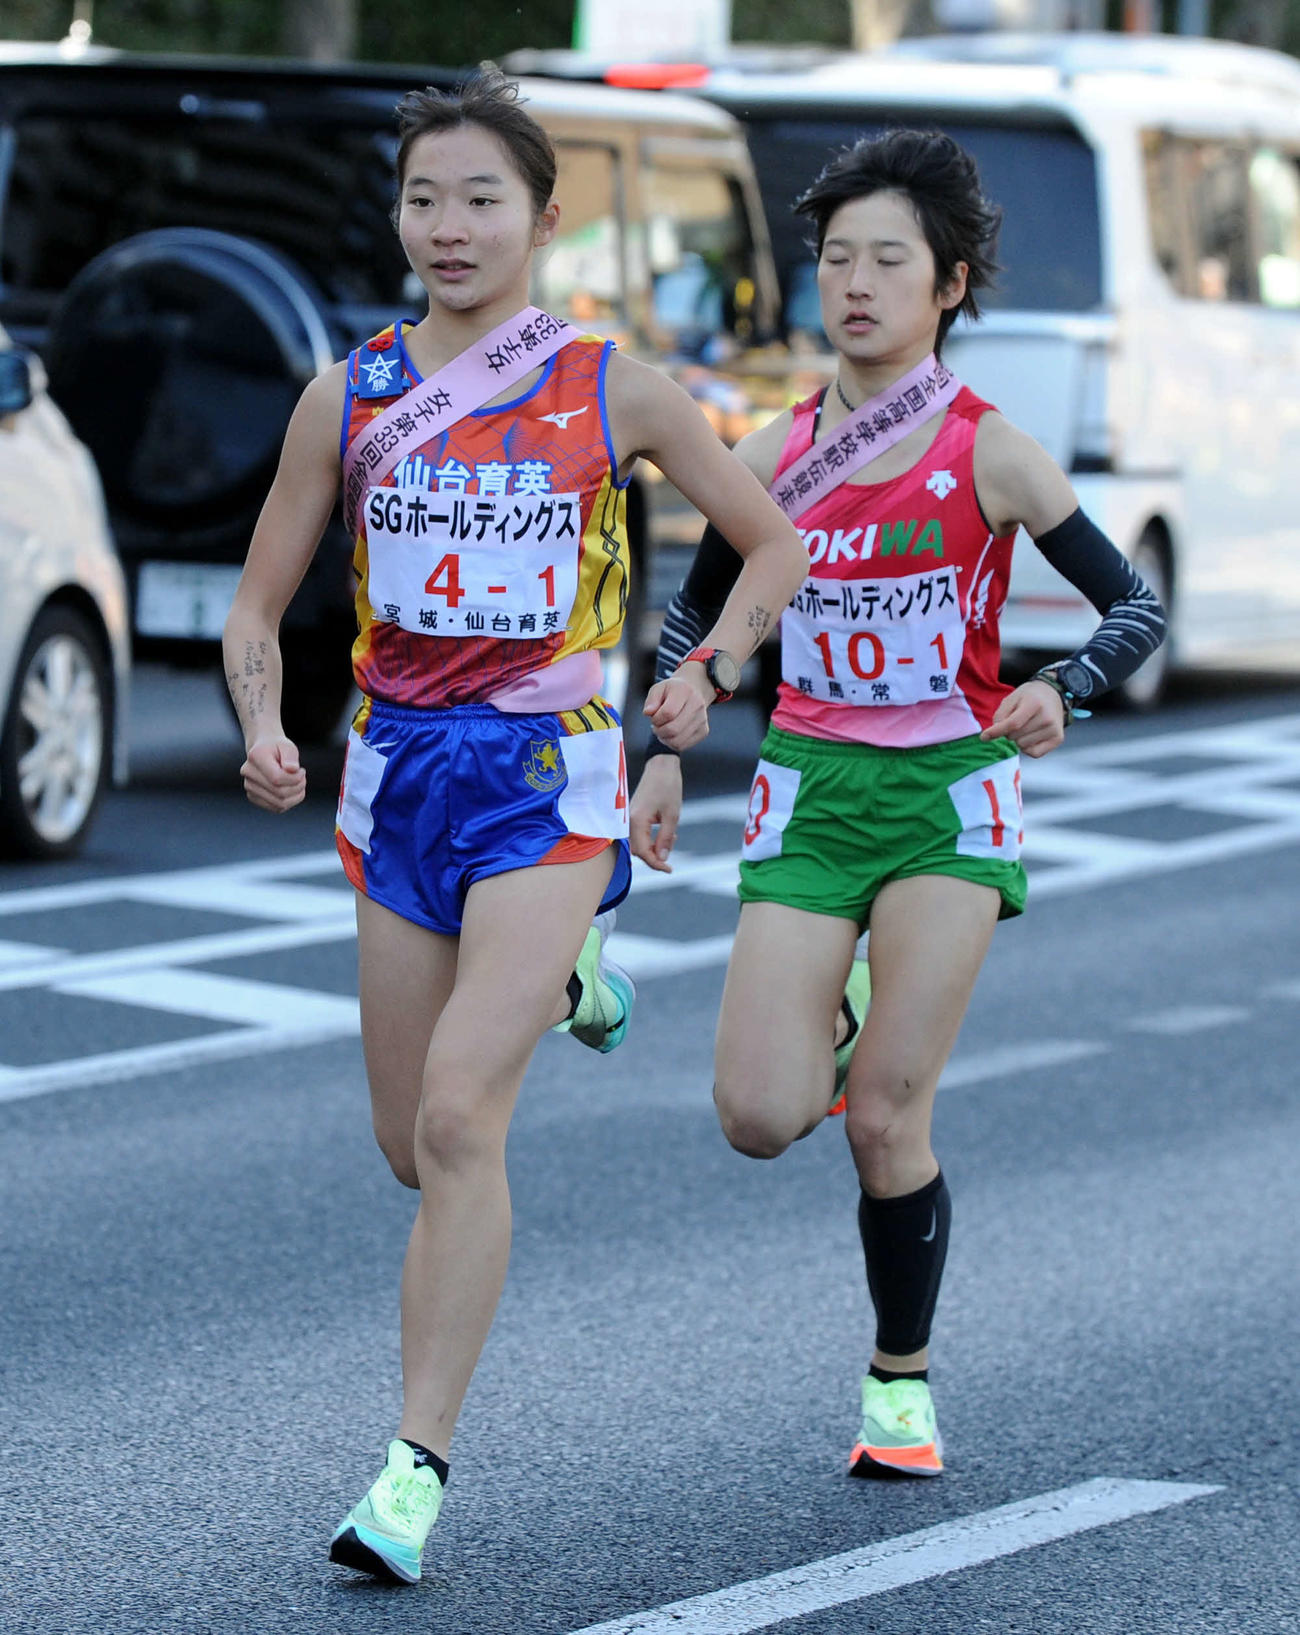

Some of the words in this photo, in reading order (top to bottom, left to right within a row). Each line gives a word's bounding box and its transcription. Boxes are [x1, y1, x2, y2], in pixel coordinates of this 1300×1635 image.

[484, 313, 569, 375] 女子第33
[371, 377, 390, 392] 勝
[778, 364, 955, 512] 回全国高等学校駅伝競走
[392, 454, 552, 497] 仙台育英
[795, 520, 945, 565] OKIWA
[789, 575, 955, 620] ホールディングス
